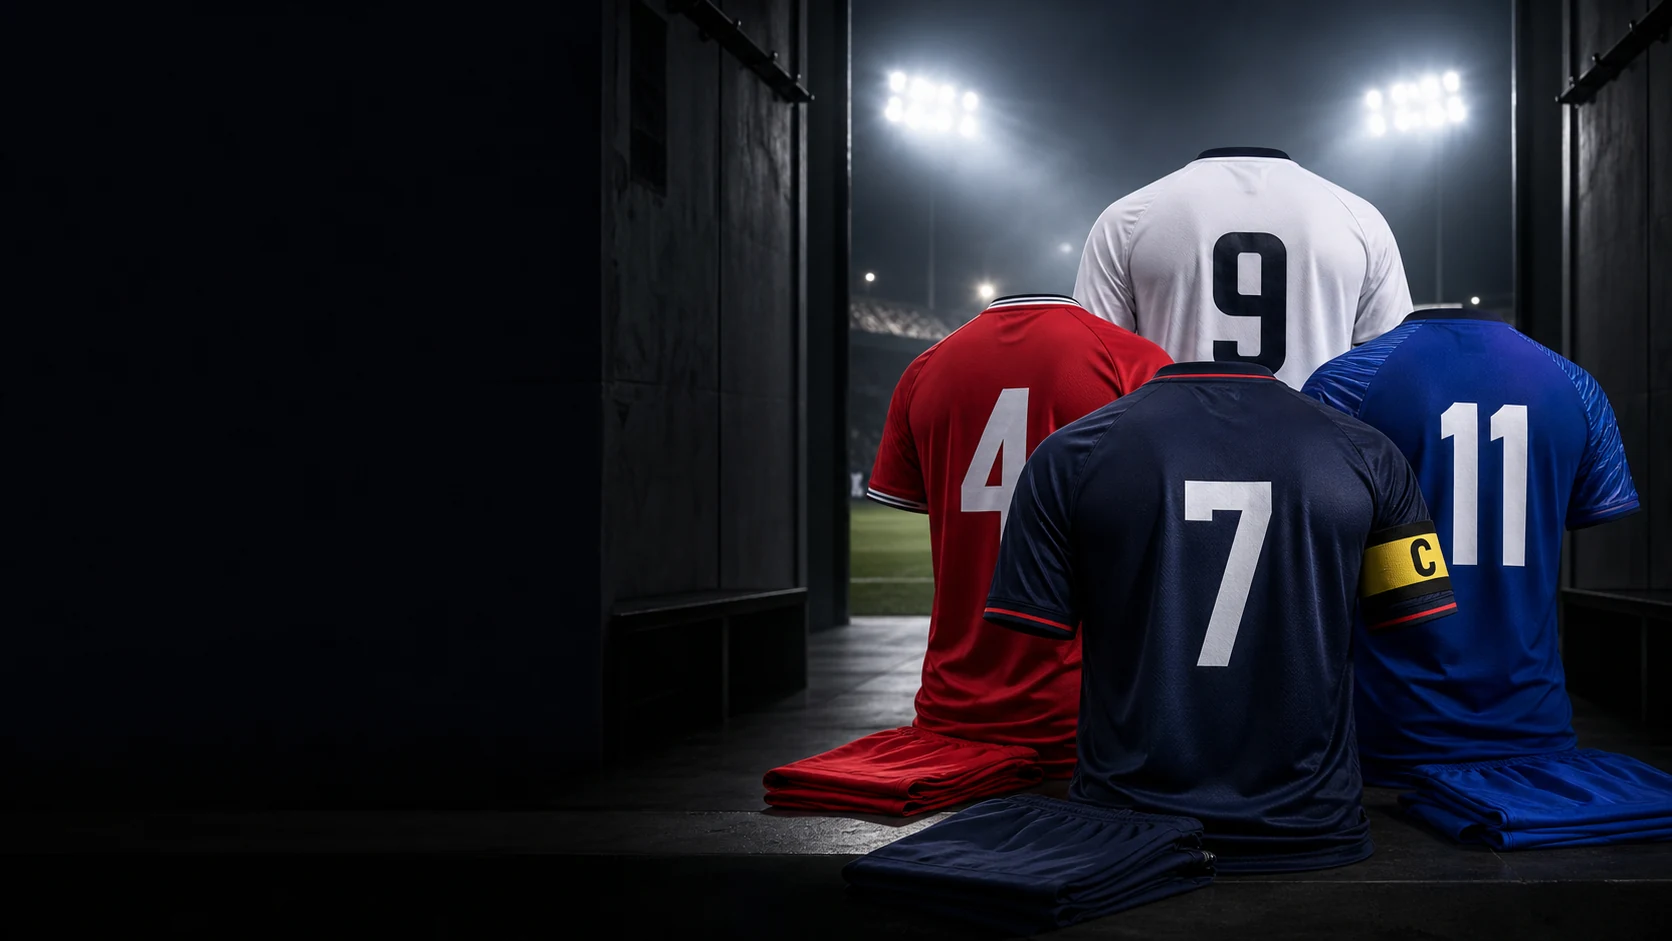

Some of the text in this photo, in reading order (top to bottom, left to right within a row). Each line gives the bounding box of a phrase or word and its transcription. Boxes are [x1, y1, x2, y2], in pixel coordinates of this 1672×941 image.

[1213, 232, 1287, 375] 9
[961, 387, 1030, 546] 4
[1440, 402, 1528, 567] 11
[1185, 480, 1272, 666] 7
[1410, 538, 1437, 577] C
